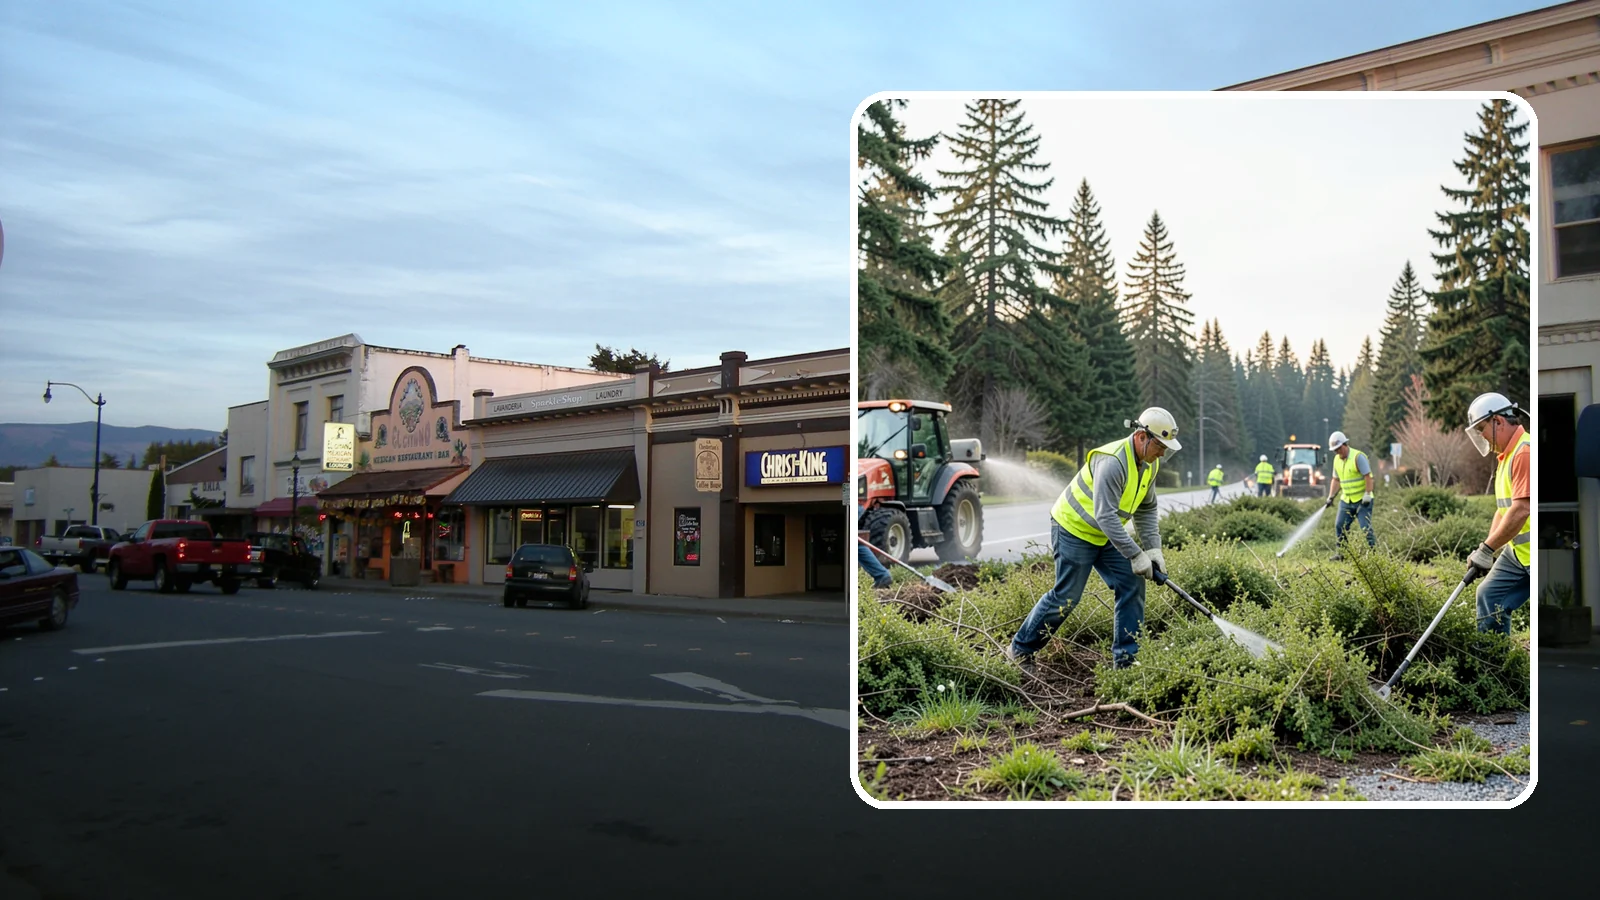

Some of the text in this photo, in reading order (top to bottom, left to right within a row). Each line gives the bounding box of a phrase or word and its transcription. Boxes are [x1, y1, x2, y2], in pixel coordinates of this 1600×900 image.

[595, 389, 623, 400] LAUNDRY
[493, 402, 522, 413] LAVANDERIA
[530, 394, 583, 409] Sparkle Shop
[373, 455, 396, 464] MEXICAN
[397, 451, 434, 463] RESTAURANT
[437, 450, 450, 459] BAR
[761, 450, 827, 478] CHRIST KING
[696, 481, 709, 489] Coffee
